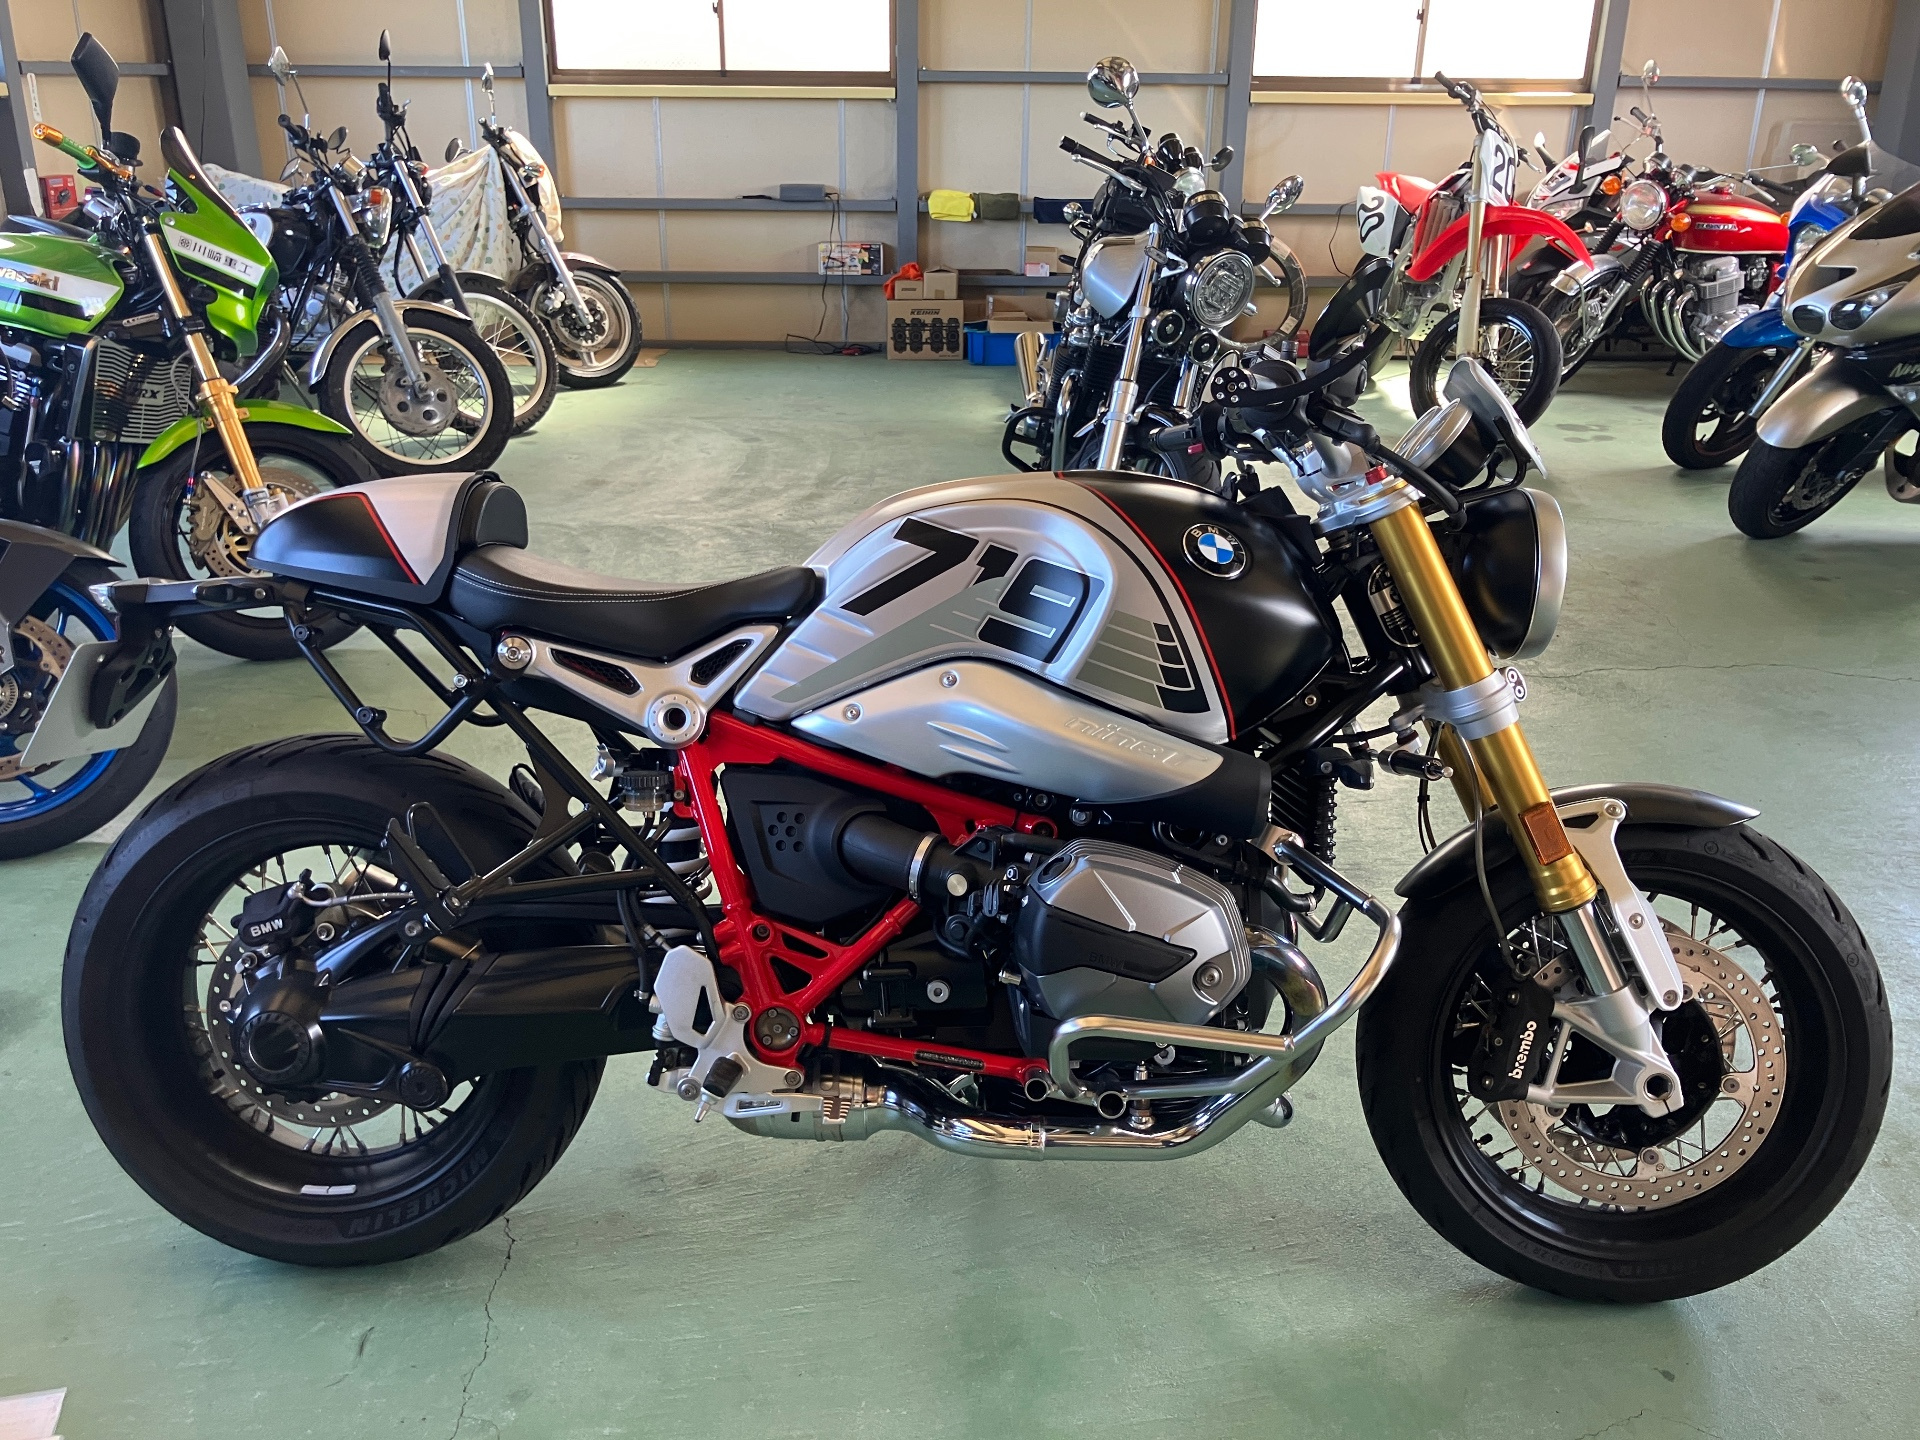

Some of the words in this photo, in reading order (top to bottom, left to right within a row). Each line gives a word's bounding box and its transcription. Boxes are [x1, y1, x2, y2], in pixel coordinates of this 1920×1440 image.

[1190, 526, 1239, 546] BMW
[250, 918, 283, 937] BMW
[1508, 1020, 1537, 1079] brembo
[348, 1147, 490, 1236] MICHELIN
